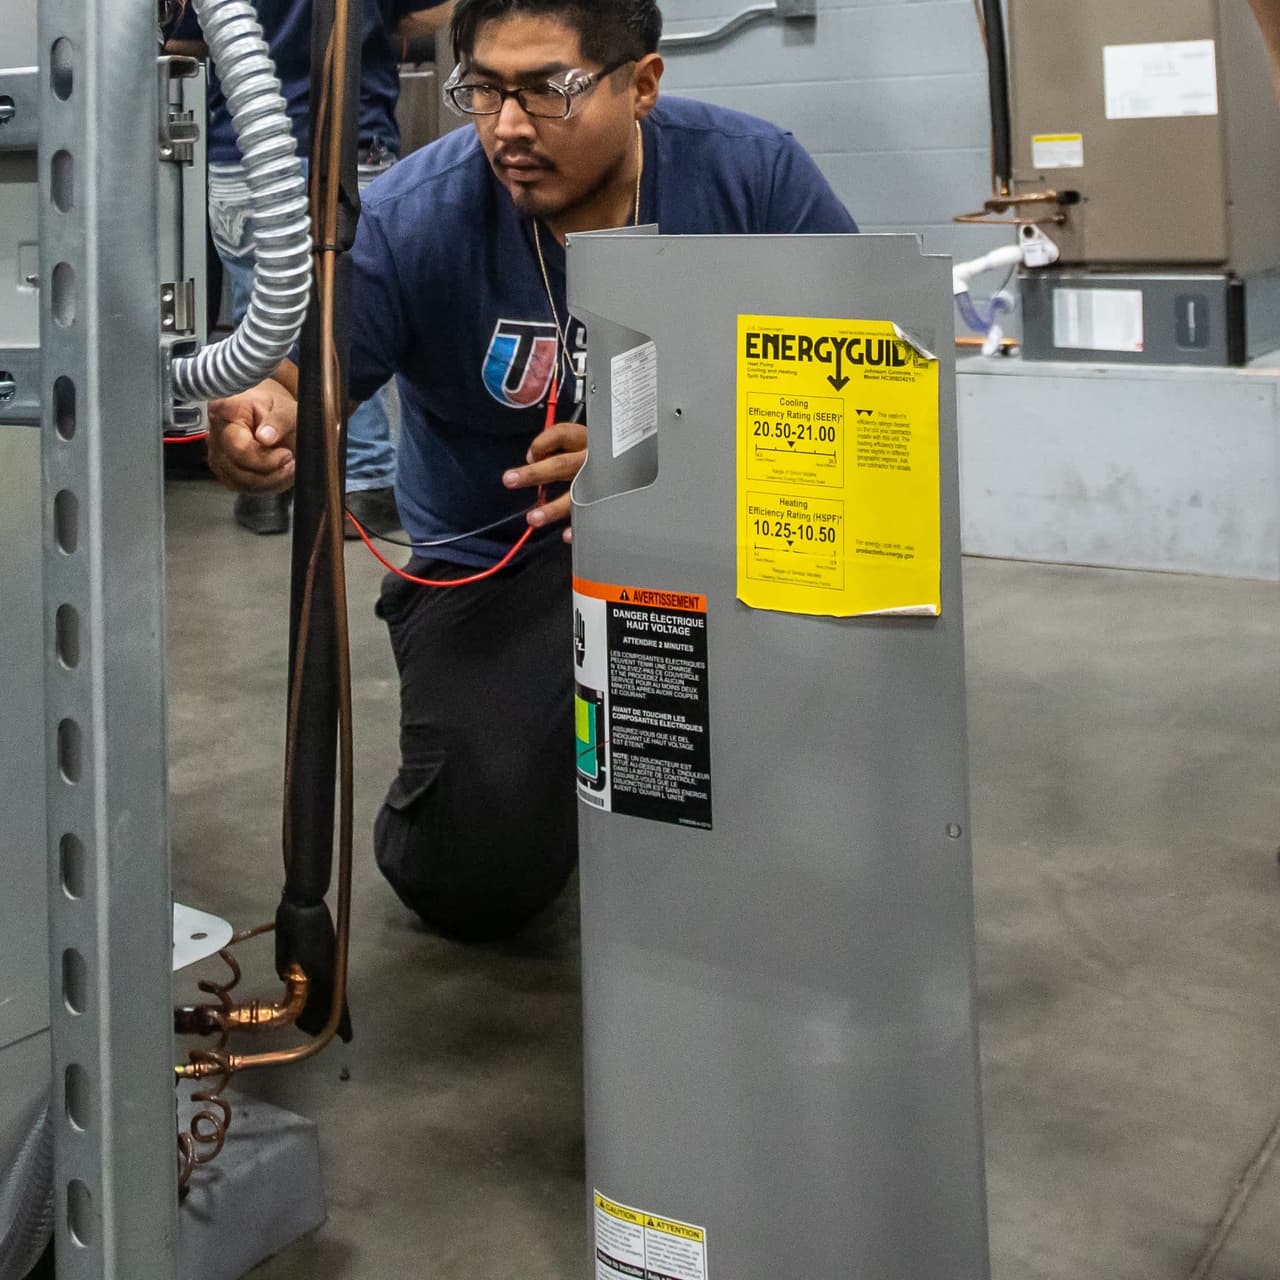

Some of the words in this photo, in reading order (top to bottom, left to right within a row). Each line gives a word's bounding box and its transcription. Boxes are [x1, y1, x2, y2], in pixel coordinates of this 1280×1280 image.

[746, 332, 928, 370] ENERGYGUID
[780, 397, 809, 409] Cooling
[748, 407, 785, 420] Efficiency
[786, 410, 811, 422] Rating
[753, 420, 836, 443] 20.50-21.00
[779, 497, 808, 510] Heating
[748, 505, 785, 520] Efficiency
[786, 509, 811, 522] Rating
[754, 519, 836, 543] 10.25-10.50
[633, 590, 700, 609] AVERTISSEMENT
[613, 608, 649, 621] DANGER
[650, 612, 704, 628] ÉLECTRIQUE
[626, 620, 649, 632] HAUT
[650, 623, 690, 636] VOLTAGE
[623, 636, 658, 648] ATTENDRE
[663, 640, 694, 652] MINUTES
[612, 705, 631, 715] AVANT
[632, 708, 642, 717] DE
[642, 709, 672, 721] TOUCHER
[673, 715, 686, 723] LES
[612, 712, 658, 726] COMPOSANTES
[605, 1203, 637, 1221] CAUTION
[656, 1221, 700, 1239] ATTENTION
